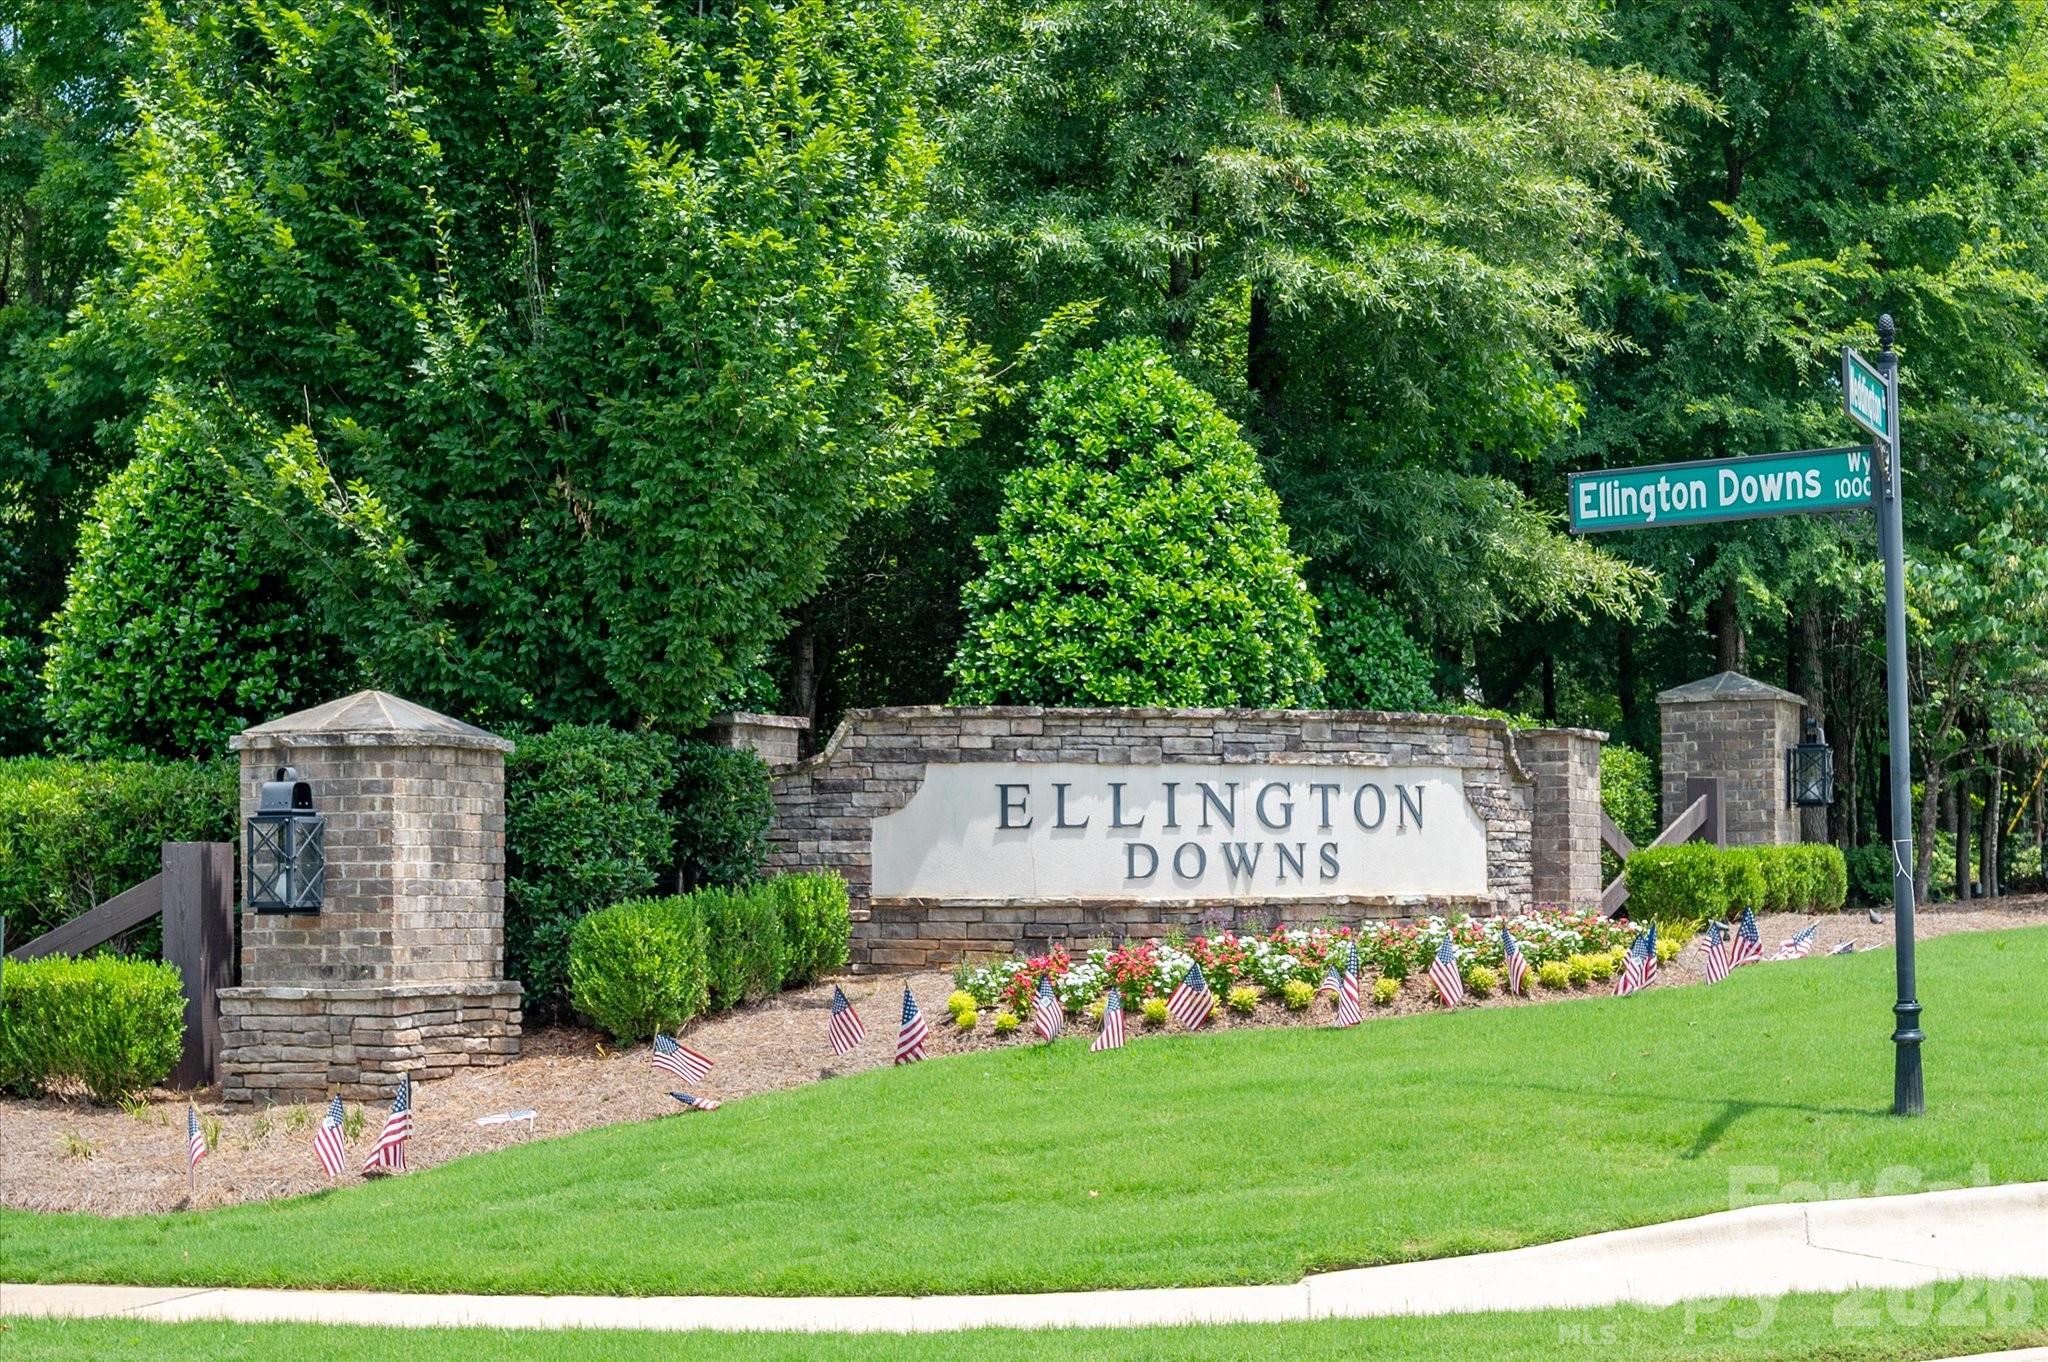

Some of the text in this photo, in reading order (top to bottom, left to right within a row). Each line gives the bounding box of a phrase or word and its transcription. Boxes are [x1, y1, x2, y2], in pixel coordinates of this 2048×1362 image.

[1847, 452, 1871, 476] Wy
[1579, 468, 1822, 522] Ellington Downs
[995, 782, 1426, 831] ELLINGTON
[1126, 841, 1341, 881] DOWNS
